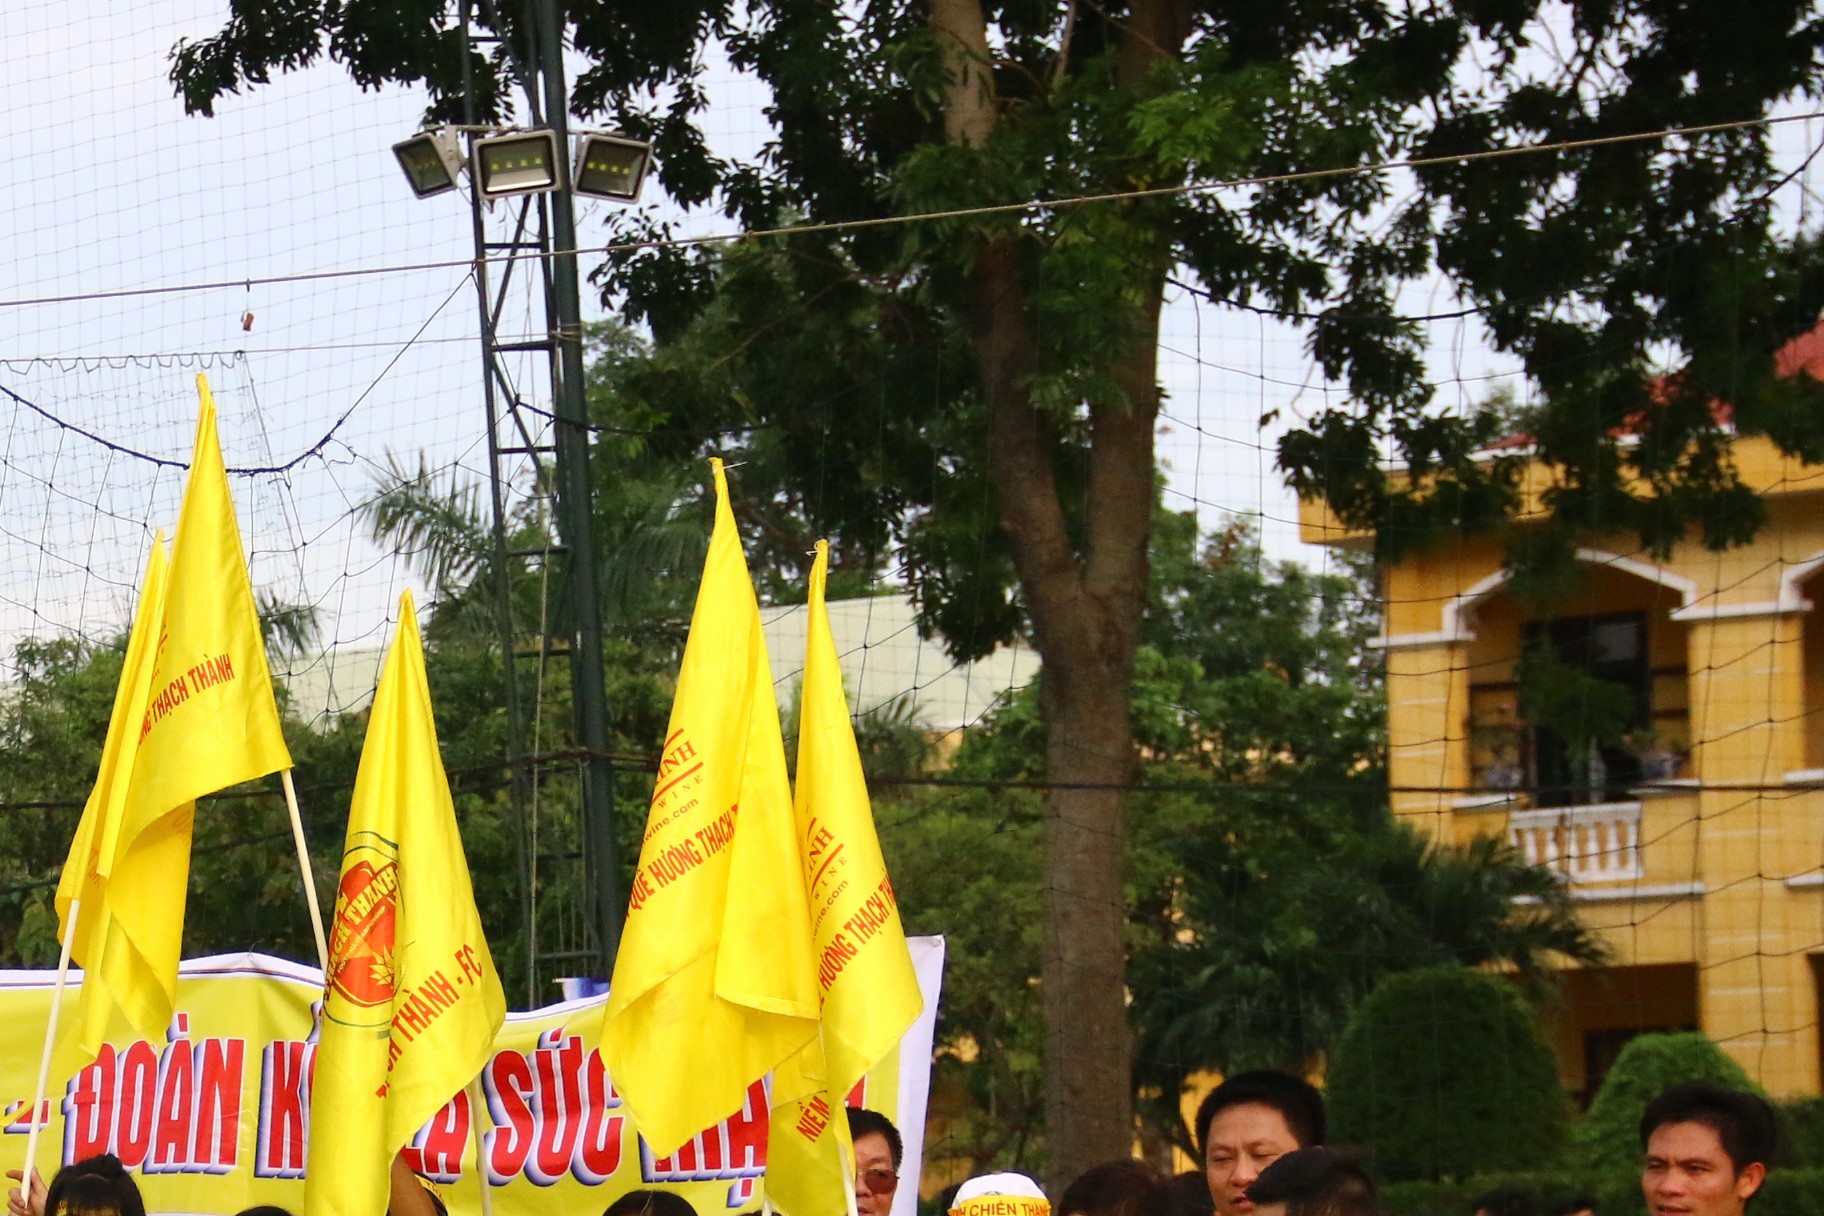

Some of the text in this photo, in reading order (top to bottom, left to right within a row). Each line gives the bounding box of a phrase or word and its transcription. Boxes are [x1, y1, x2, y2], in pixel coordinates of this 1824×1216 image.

[188, 653, 235, 693] THÀNH
[392, 970, 459, 1042] THÀNH
[455, 944, 482, 986] FC
[64, 1013, 245, 1173] ĐOÀN
[484, 1026, 625, 1187] SỨC
